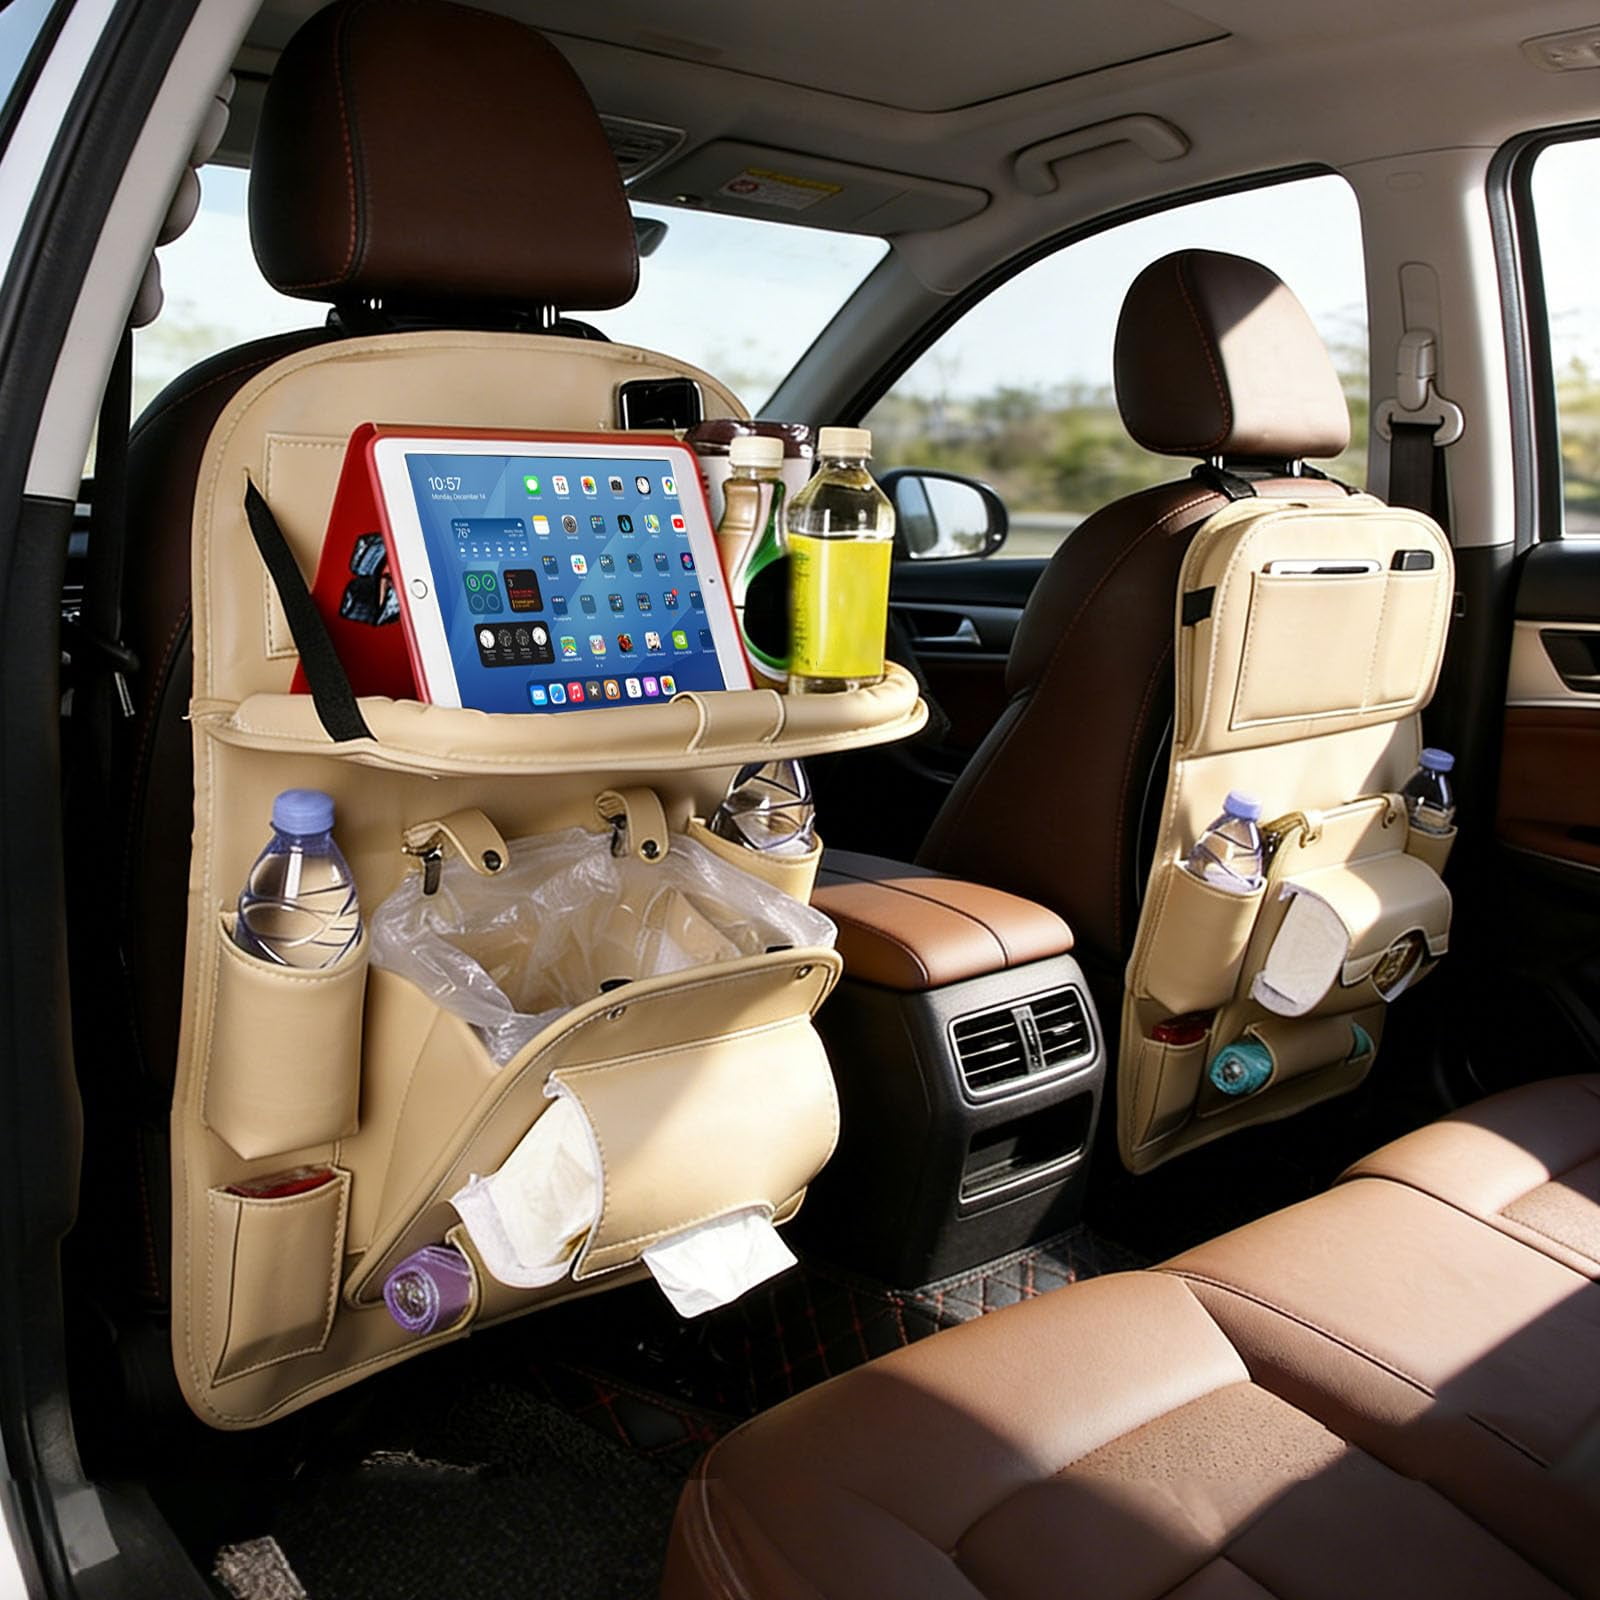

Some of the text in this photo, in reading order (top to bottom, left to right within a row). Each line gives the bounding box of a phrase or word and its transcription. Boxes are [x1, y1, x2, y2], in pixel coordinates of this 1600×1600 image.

[428, 476, 461, 491] 10:57
[555, 481, 566, 492] 14
[431, 493, 453, 501] Monday,
[630, 684, 638, 695] 3
